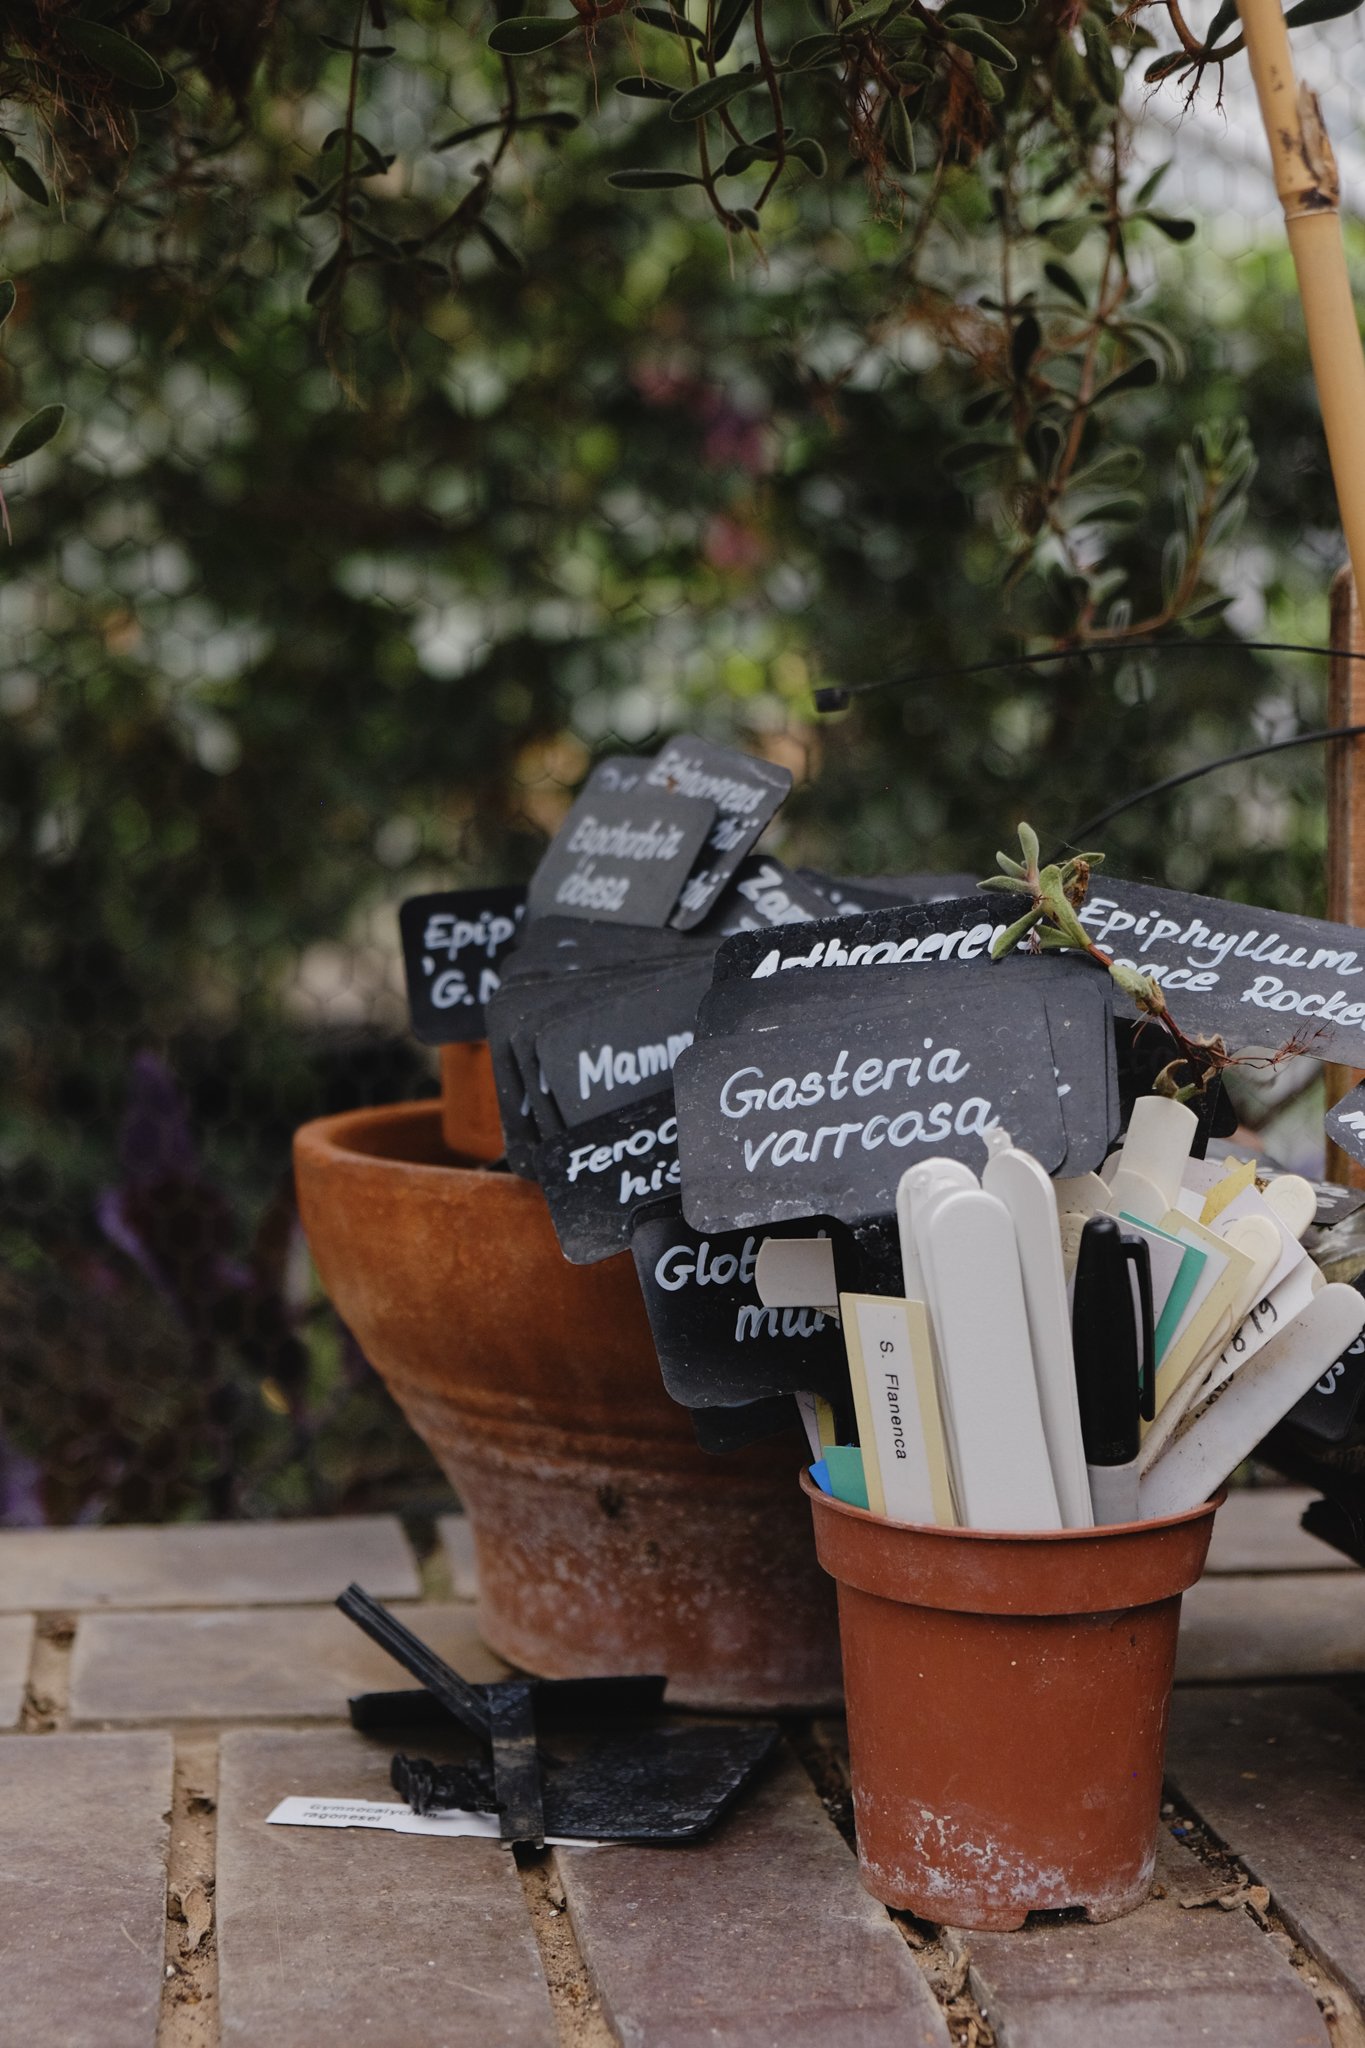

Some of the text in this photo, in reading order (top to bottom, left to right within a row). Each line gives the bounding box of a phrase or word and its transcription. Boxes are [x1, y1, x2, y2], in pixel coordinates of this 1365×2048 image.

[424, 905, 525, 961] Epip
[1077, 898, 1363, 976] Epiphyllum
[1240, 976, 1365, 1032] Rocke
[720, 1038, 971, 1118] Gasteria
[879, 1340, 907, 1460] S. Flanenca
